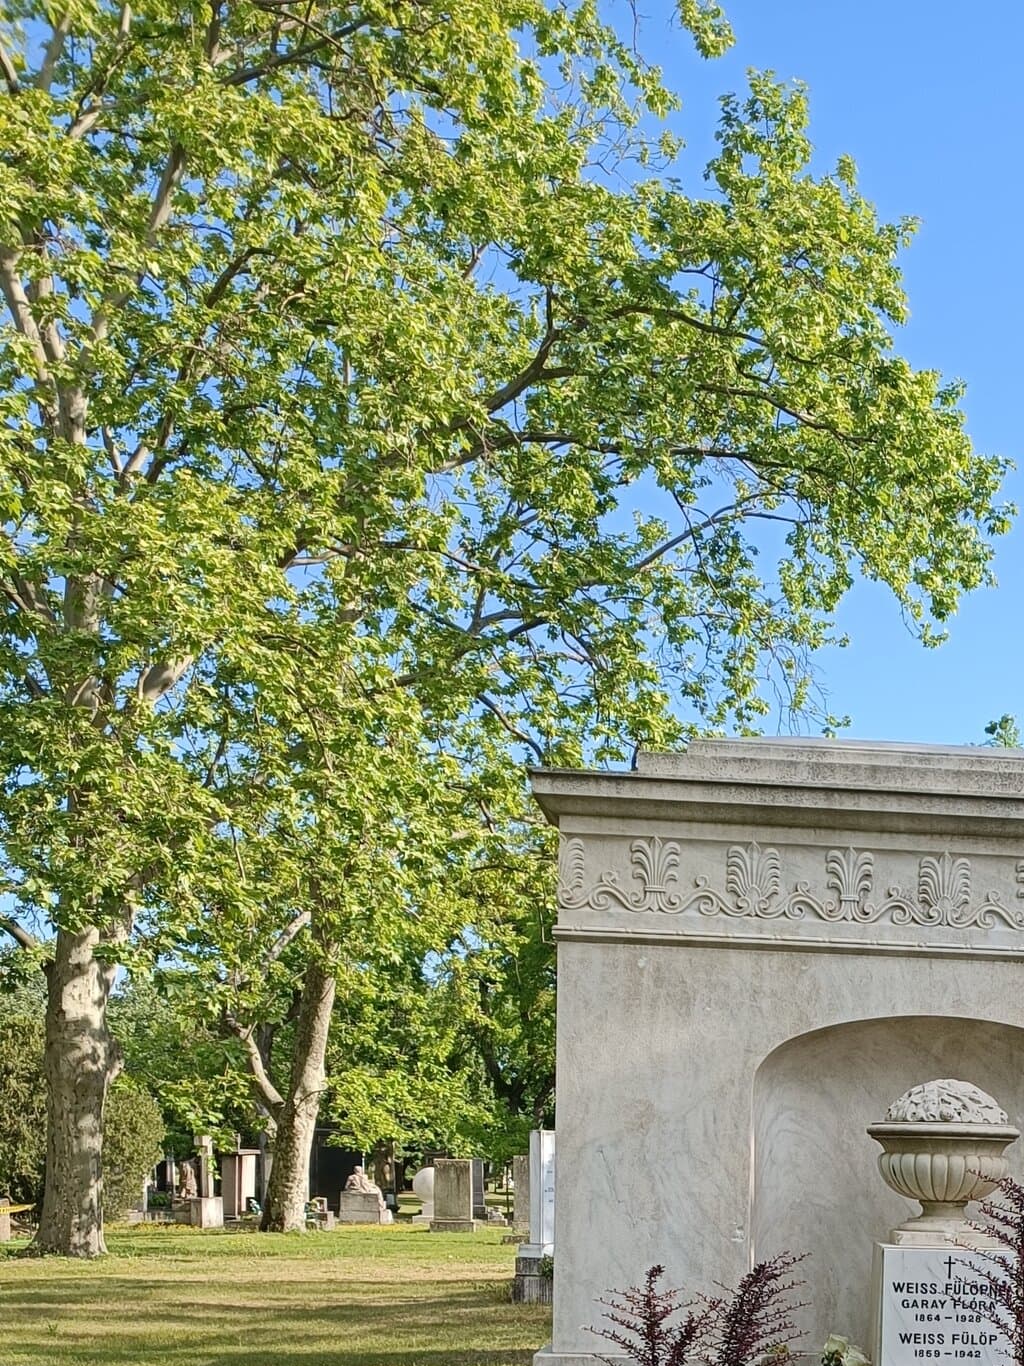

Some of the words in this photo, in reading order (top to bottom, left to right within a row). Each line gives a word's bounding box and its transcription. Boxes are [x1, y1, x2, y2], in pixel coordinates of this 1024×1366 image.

[892, 1281, 938, 1295] WEISS
[901, 1299, 948, 1310] GARAY
[953, 1296, 997, 1311] FLÓRA
[915, 1313, 941, 1322] 1864
[955, 1313, 982, 1323] 1928
[898, 1332, 945, 1345] WEISS
[951, 1331, 998, 1345] FÜLÖP
[954, 1350, 982, 1358] 1942
